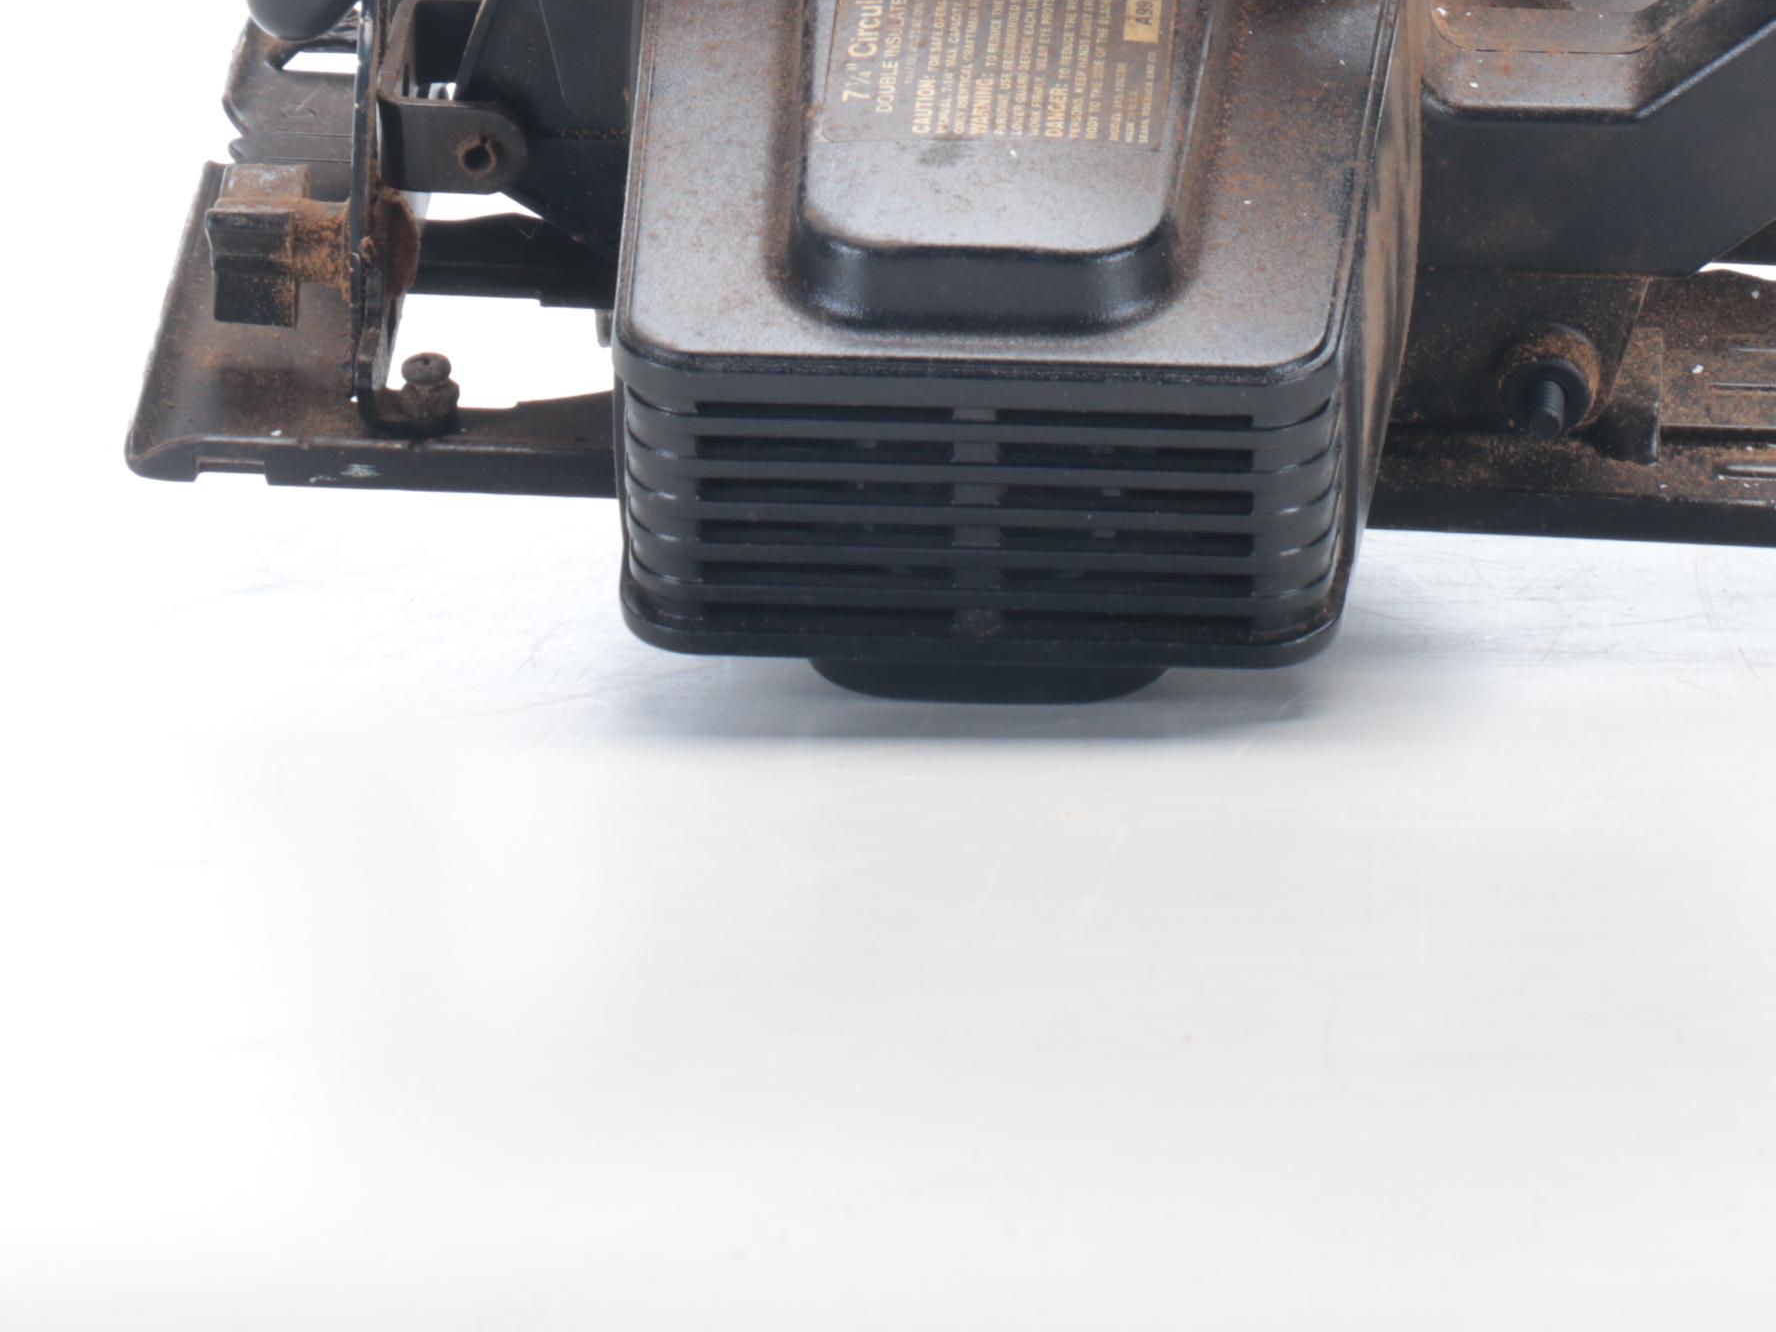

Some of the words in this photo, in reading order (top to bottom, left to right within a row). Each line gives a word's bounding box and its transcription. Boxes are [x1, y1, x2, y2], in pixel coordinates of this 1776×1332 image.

[1021, 9, 1037, 35] EACH
[1063, 11, 1078, 30] THE
[1078, 10, 1094, 37] AWAY
[929, 29, 944, 52] SAFE
[961, 8, 980, 61] CRAFTSMAN
[986, 17, 1002, 53] REDUCE
[1000, 2, 1021, 71] RECOMMENDED
[1037, 24, 1053, 44] EYE
[1094, 26, 1110, 44] THE
[984, 54, 998, 67] TO
[1017, 35, 1034, 71] BEFORE
[1034, 44, 1050, 70] WEAR
[1059, 30, 1075, 66] REDUCE
[1075, 37, 1091, 69] HANDS
[1093, 43, 1108, 58] OF
[926, 52, 941, 72] FOR
[1057, 67, 1071, 80] TO
[1090, 58, 1106, 79] SIDE
[1144, 62, 1157, 80] AND
[874, 58, 899, 113] DOUBLE
[955, 62, 973, 109] IDENTICAL
[998, 71, 1013, 90] USE
[1013, 71, 1030, 103] GUARD
[1072, 69, 1088, 93] KEEP
[1088, 80, 1103, 98] THE
[910, 74, 937, 133] CAUTION:
[968, 71, 996, 135] WARNING:
[1043, 82, 1070, 137] DANGER:
[1086, 99, 1101, 112] TO
[1140, 80, 1155, 116] ROEBUCK
[952, 111, 967, 134] ONLY
[1009, 103, 1026, 136] LOWER
[1026, 108, 1043, 136] WORK
[1083, 113, 1100, 139] BODY
[1107, 110, 1123, 141] MODEL
